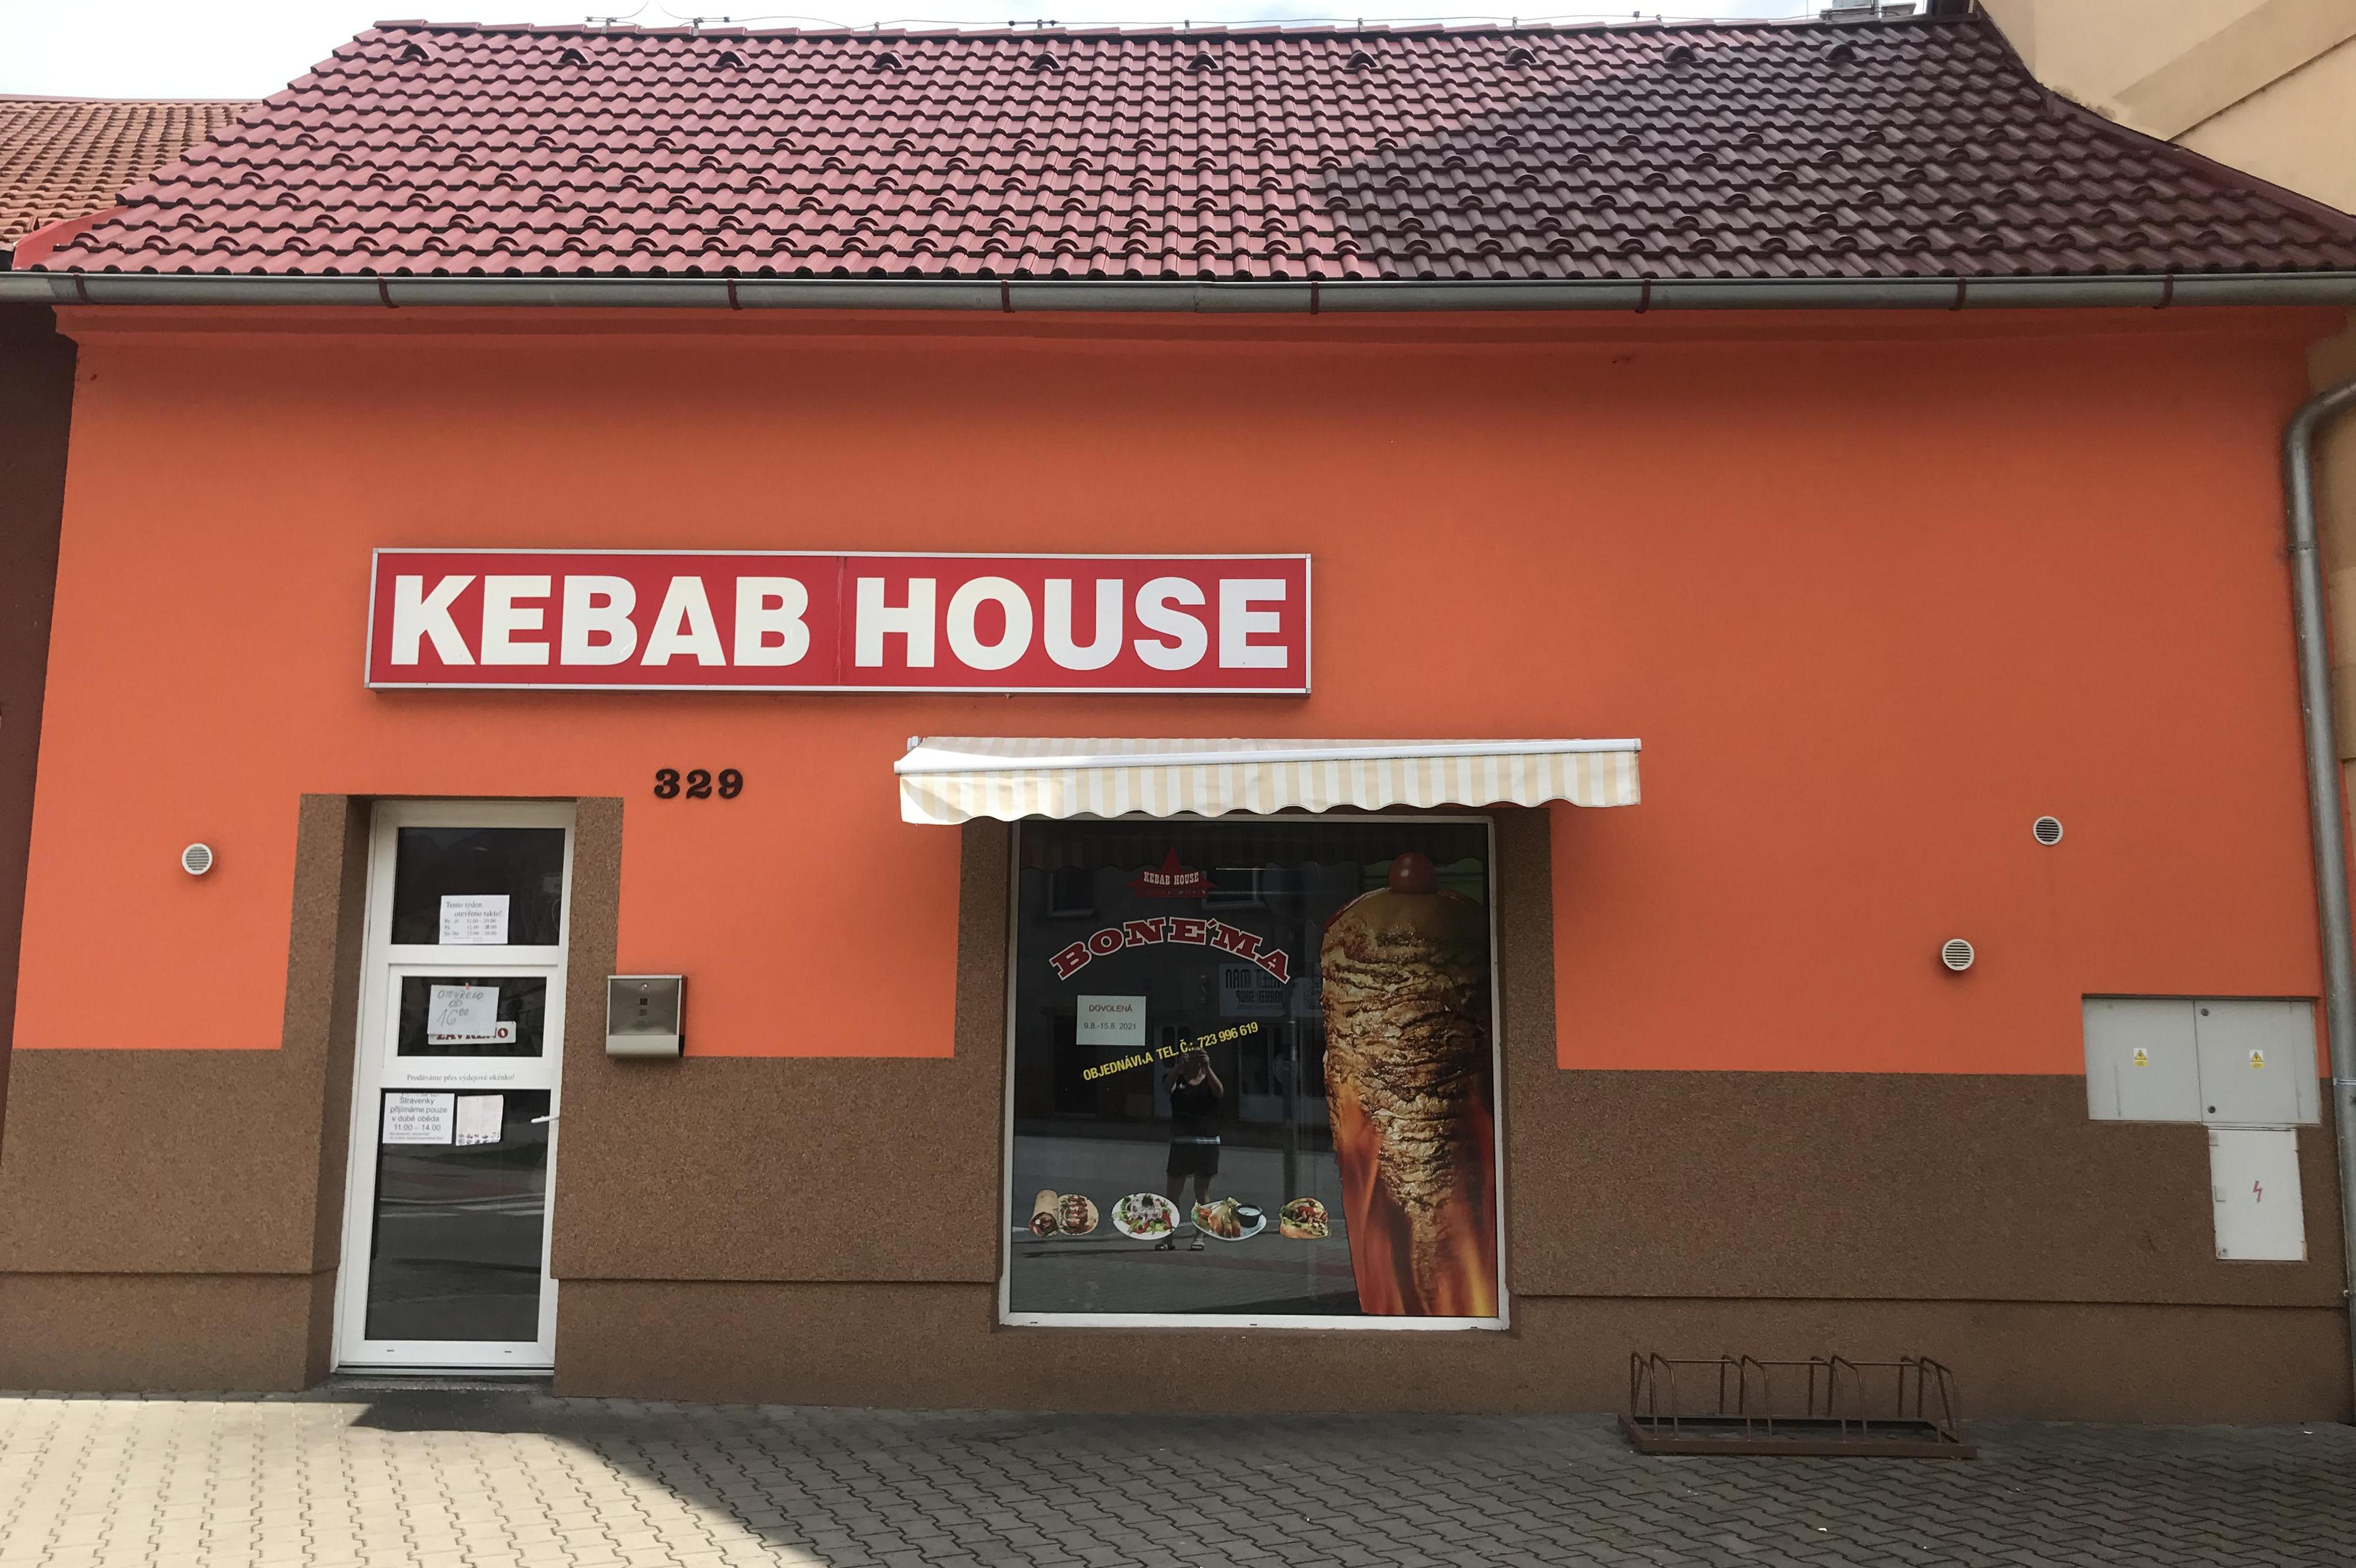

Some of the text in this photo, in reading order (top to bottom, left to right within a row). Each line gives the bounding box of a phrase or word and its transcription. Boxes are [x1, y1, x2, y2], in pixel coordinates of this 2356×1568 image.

[391, 575, 1288, 671] KEBAB HOUSE
[654, 768, 743, 799] 329
[1144, 871, 1199, 885] KEBAB HOUSE
[1156, 1046, 1179, 1060] TEL.
[1197, 1034, 1217, 1048] 723
[1219, 1027, 1238, 1042] 996
[1239, 1021, 1259, 1036] 619
[444, 1074, 457, 1083] přes
